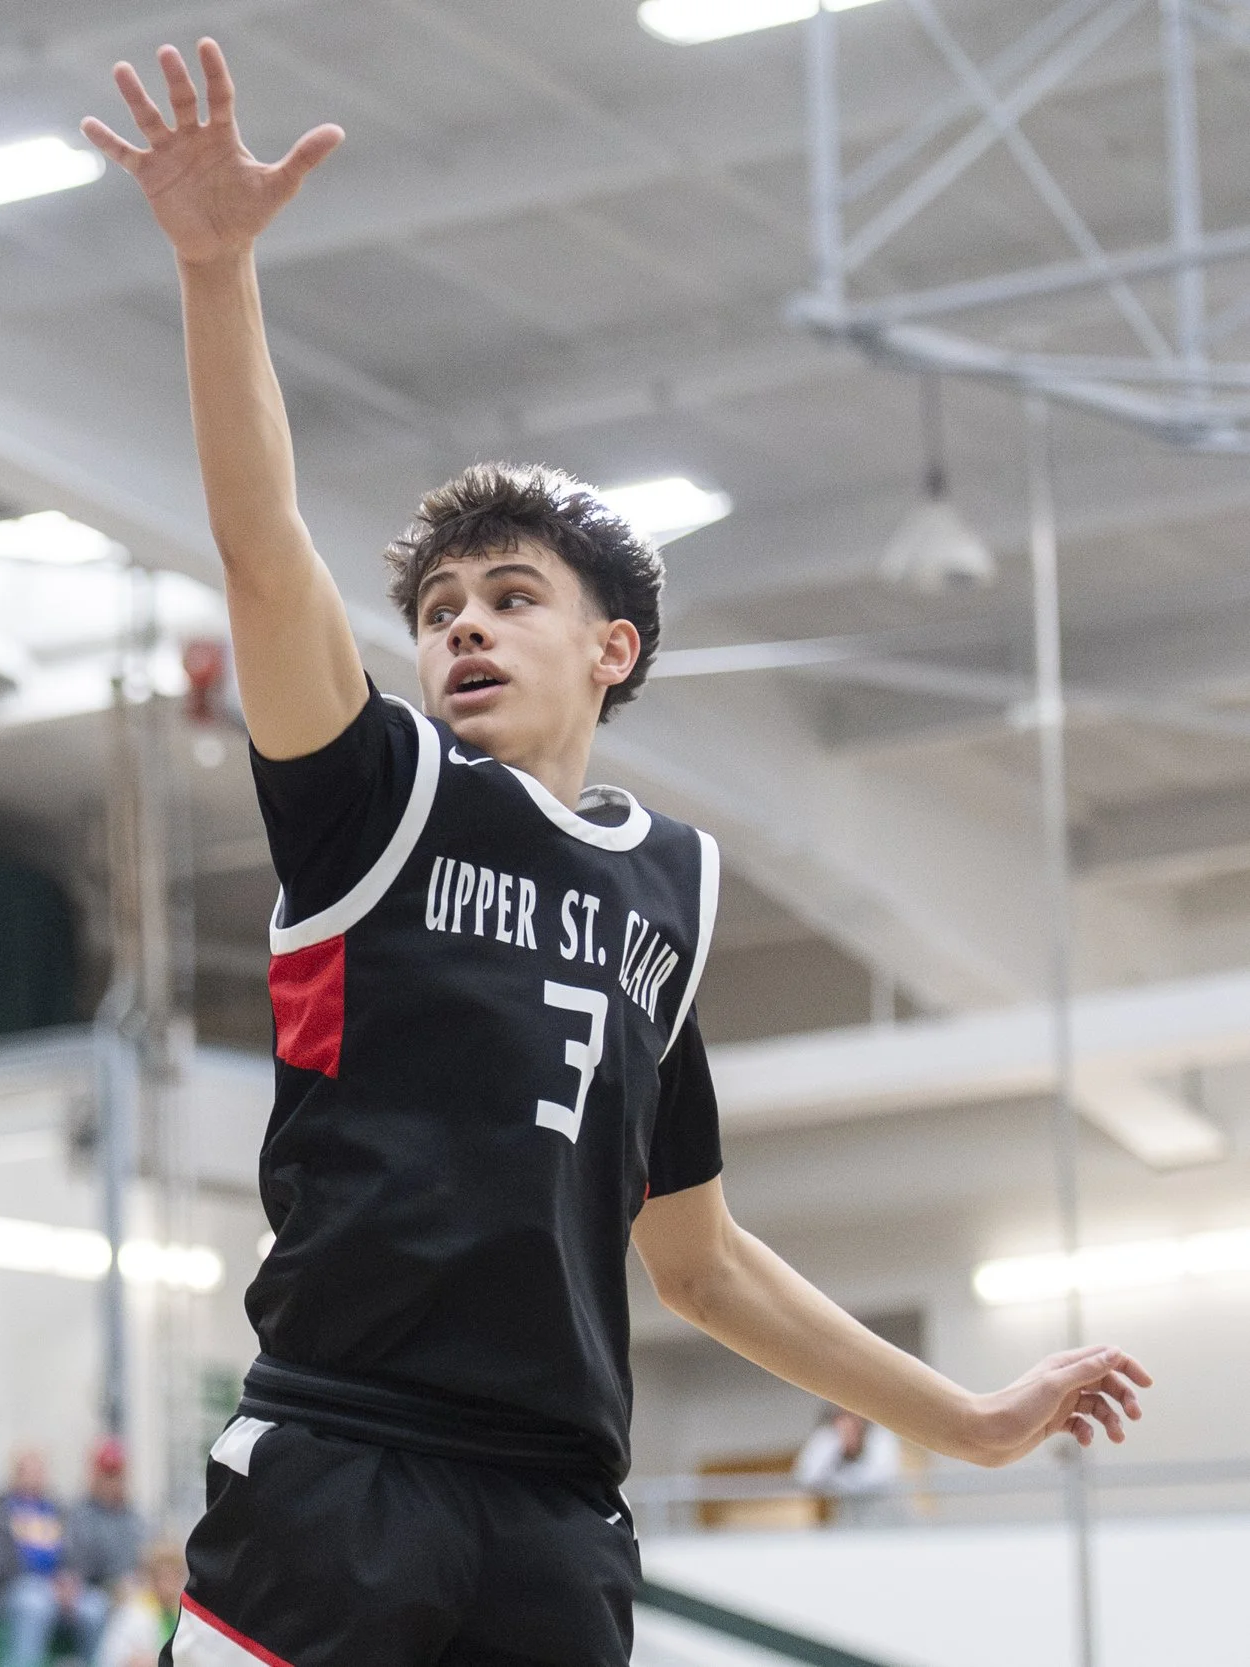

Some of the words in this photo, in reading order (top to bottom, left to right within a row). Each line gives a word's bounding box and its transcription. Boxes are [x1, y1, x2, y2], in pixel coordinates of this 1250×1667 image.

[424, 855, 538, 951] UPPER
[558, 888, 607, 967] ST.
[617, 909, 680, 1024] CLAIR
[535, 979, 609, 1145] 3
